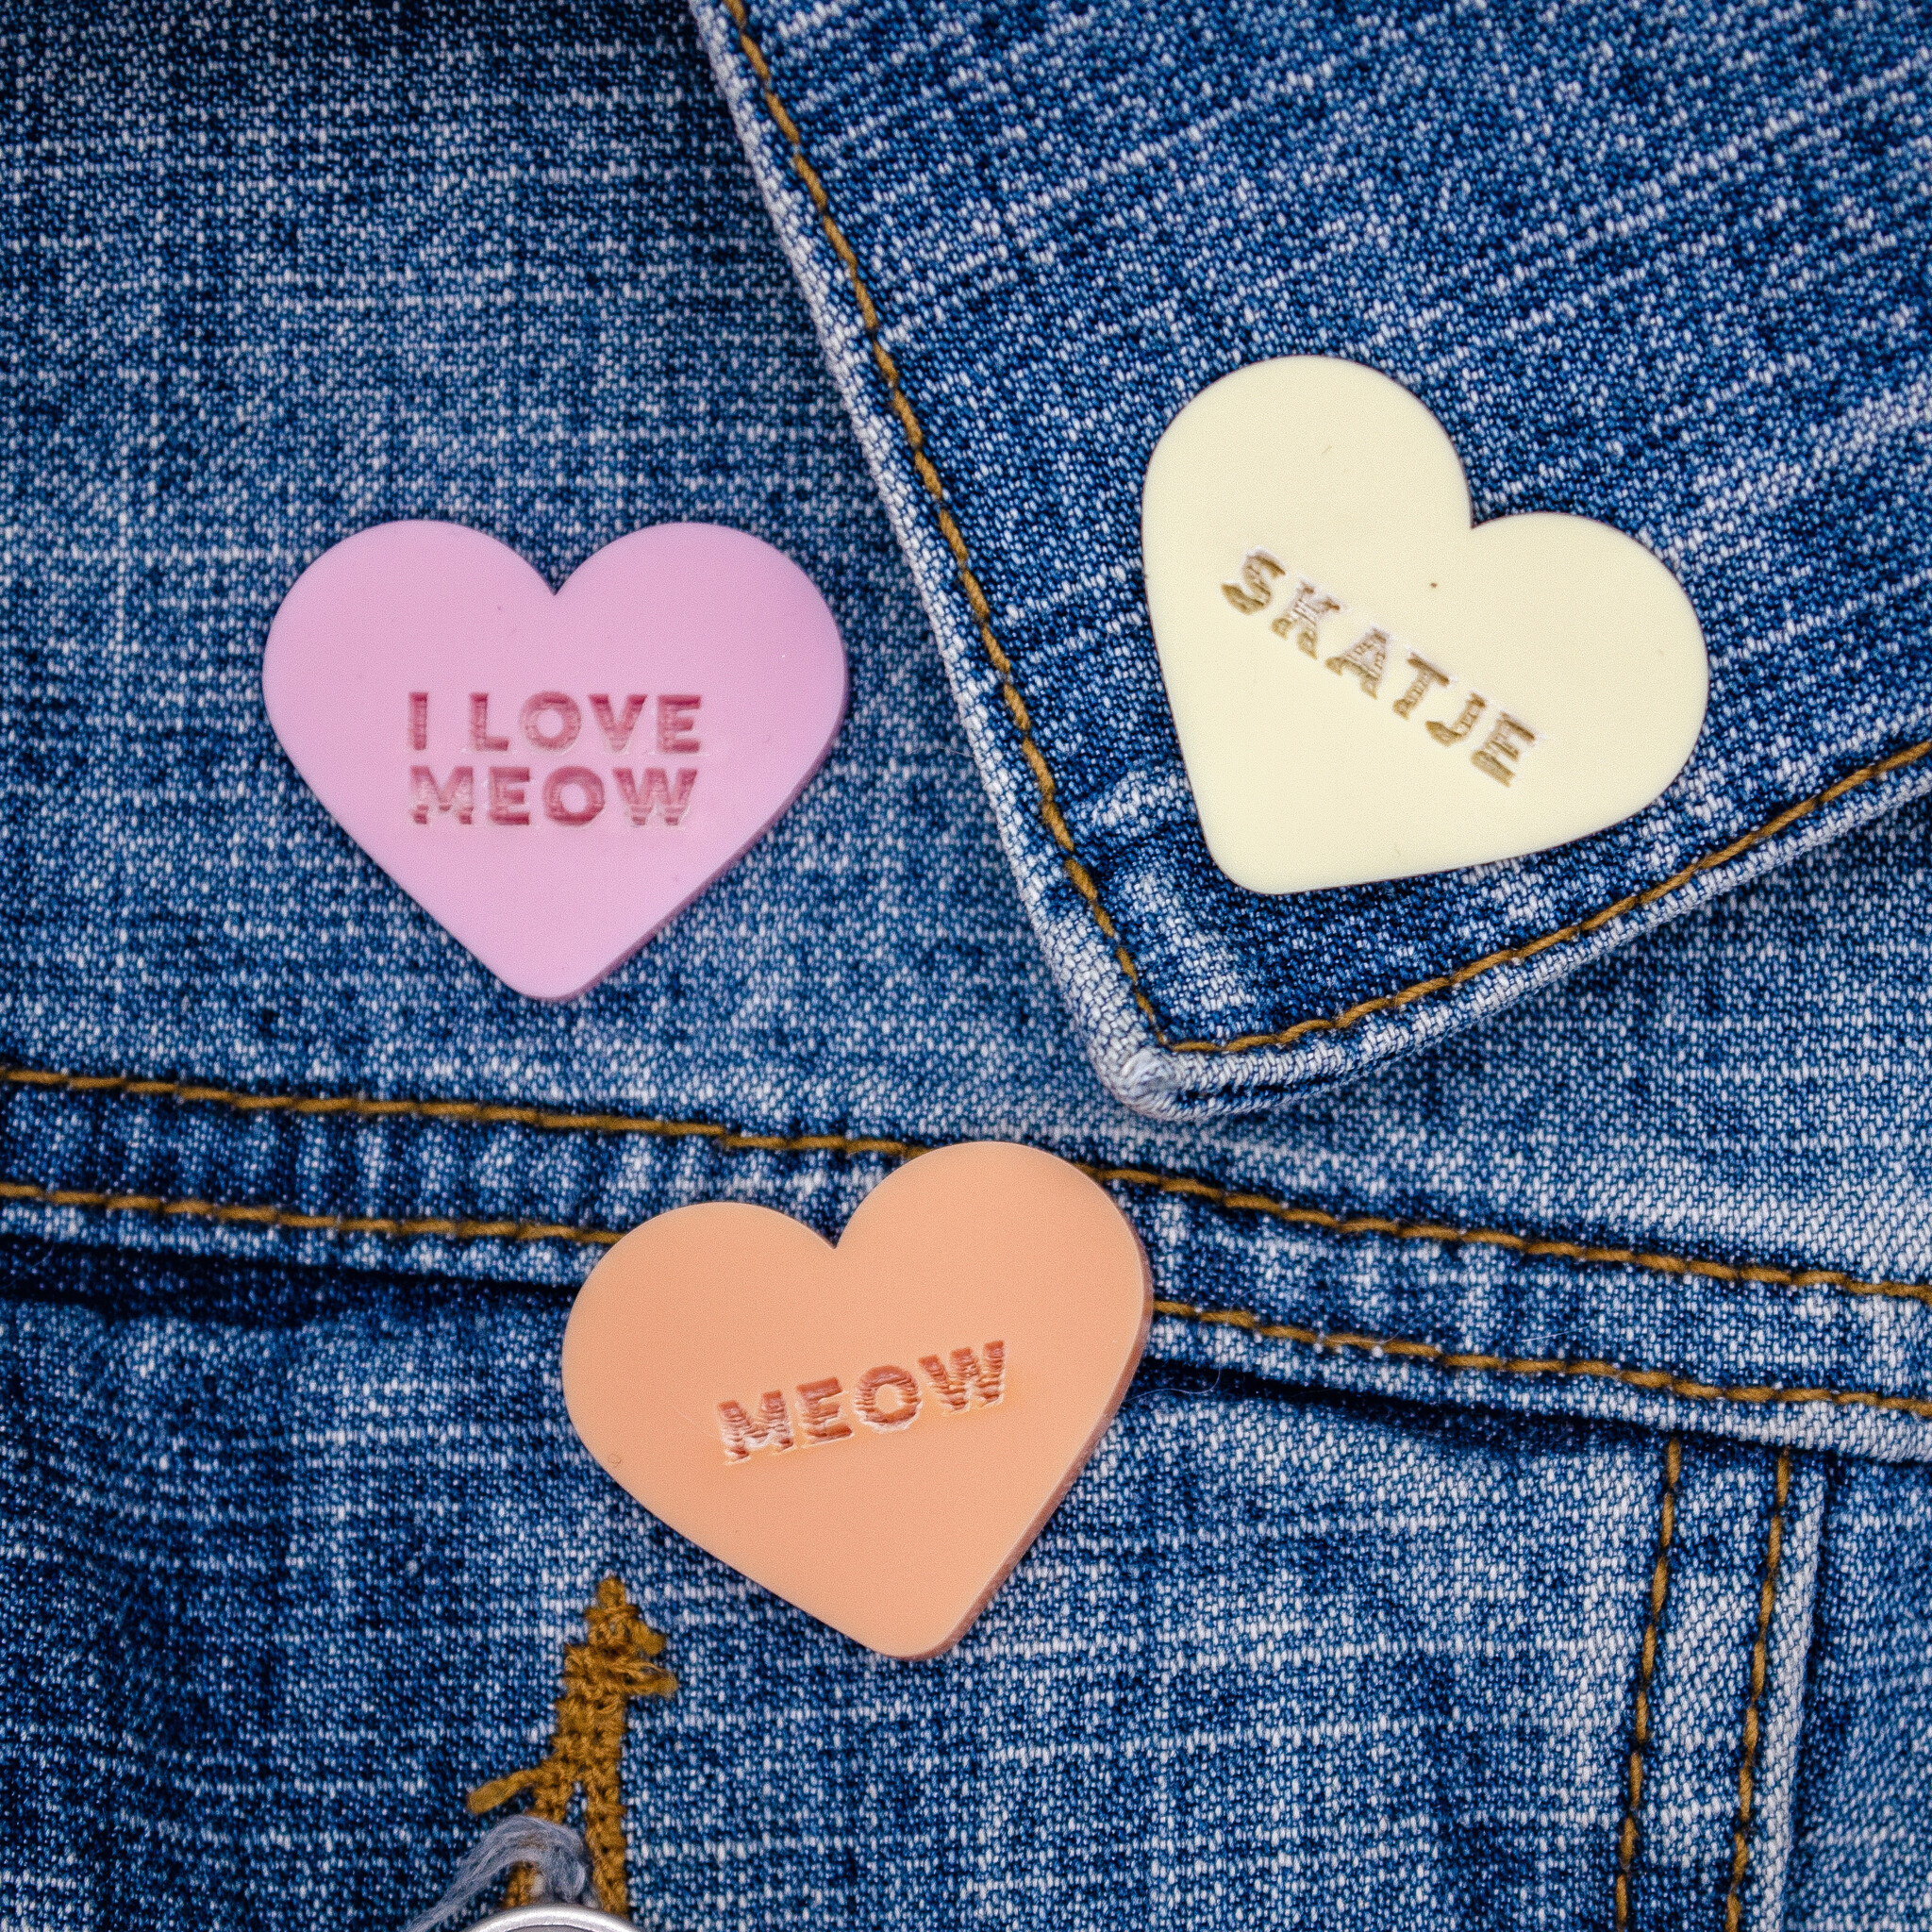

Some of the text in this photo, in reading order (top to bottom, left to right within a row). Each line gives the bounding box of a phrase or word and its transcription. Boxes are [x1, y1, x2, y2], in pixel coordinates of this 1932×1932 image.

[1221, 546, 1538, 788] SKATJE
[408, 691, 702, 753] I LOVE
[409, 765, 698, 826] MEOW
[717, 1340, 1006, 1464] MEOW
